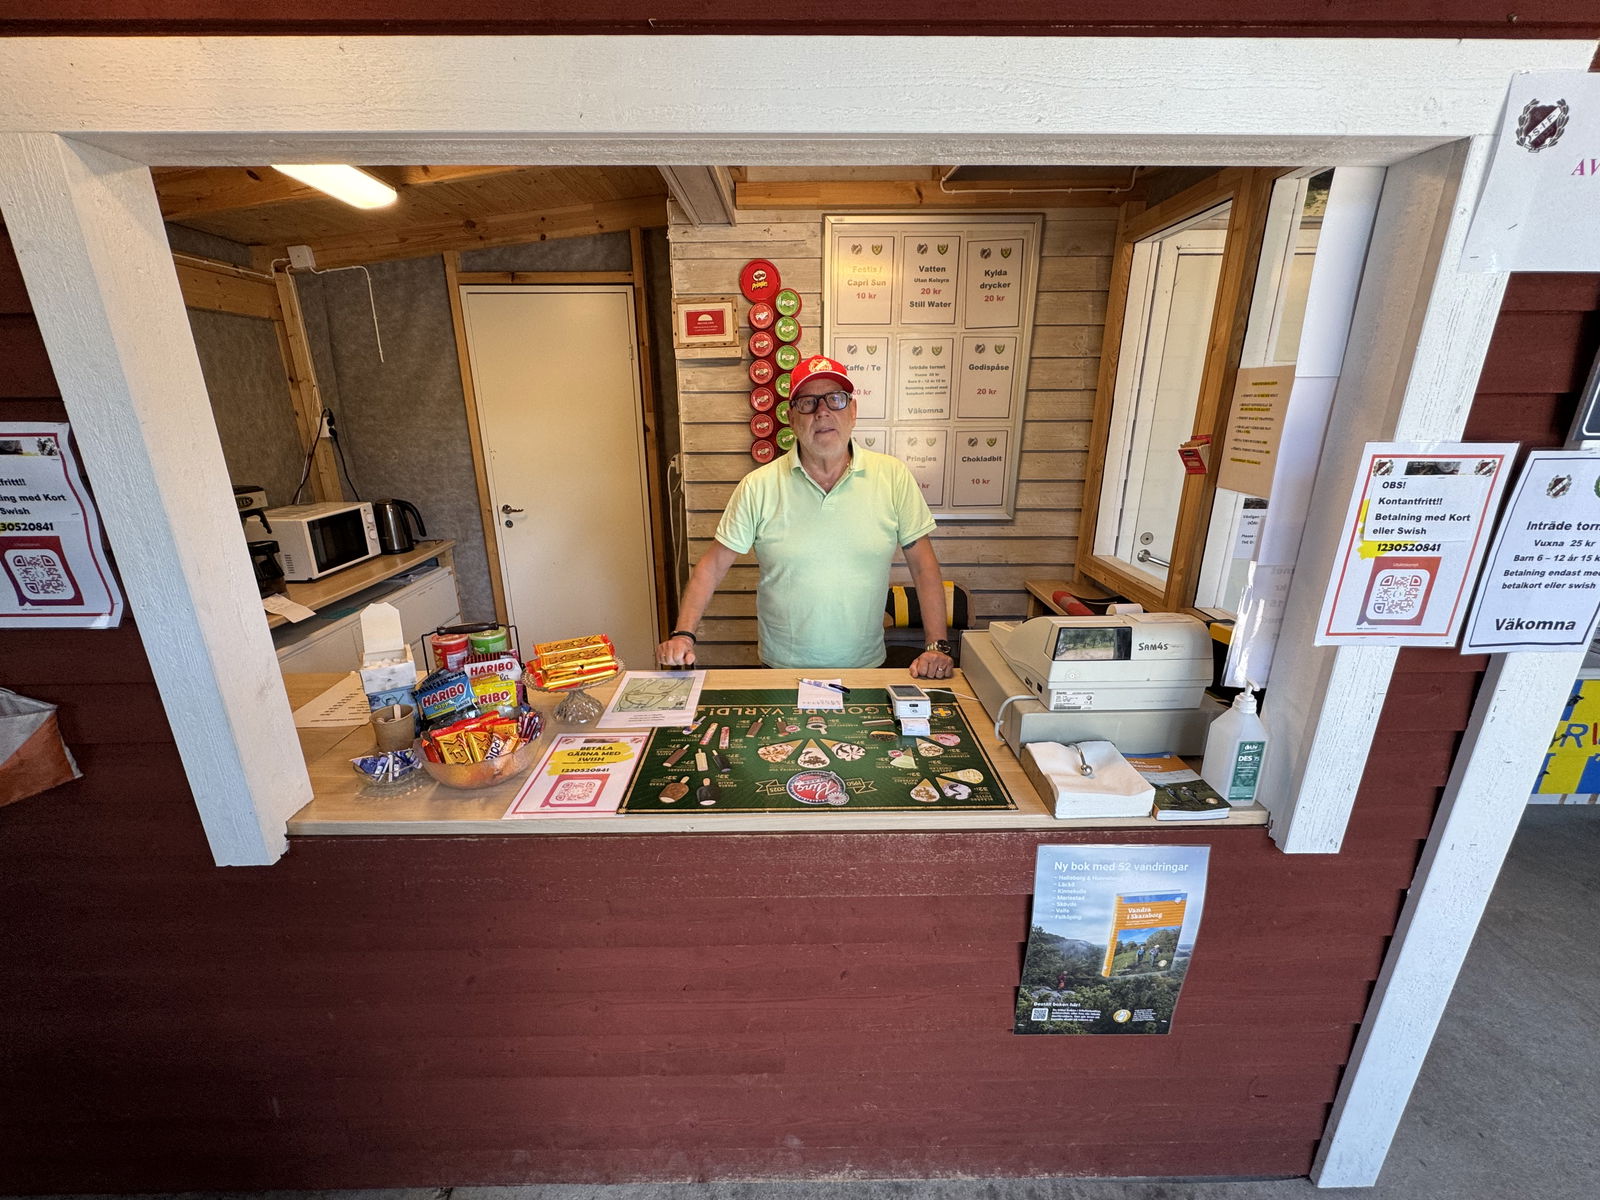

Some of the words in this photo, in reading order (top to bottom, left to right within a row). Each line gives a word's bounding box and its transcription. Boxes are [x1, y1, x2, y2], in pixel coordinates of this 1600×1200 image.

[919, 265, 946, 273] Vatten
[984, 269, 1008, 278] Kylda
[847, 279, 869, 287] Capri
[979, 282, 1011, 291] drycker
[932, 287, 942, 295] kr
[968, 364, 1010, 372] Godispåse
[1381, 481, 1406, 490] OBS!
[1378, 497, 1443, 506] Kontantfritt!!
[0, 507, 31, 515] Swish
[1375, 513, 1422, 523] Betalning
[1424, 513, 1446, 522] med
[1449, 513, 1471, 522] Kort
[0, 522, 54, 531] 30520841
[1526, 520, 1573, 531] Inträde
[1372, 527, 1395, 535] eller
[1397, 527, 1427, 535] Swish
[1376, 543, 1442, 552] 1230520841
[1533, 539, 1565, 547] Vuxna
[1569, 539, 1583, 547] 25
[1584, 539, 1597, 547] kr
[1513, 554, 1535, 562] Barn
[1537, 554, 1543, 562] 6
[1554, 554, 1566, 562] 12
[1567, 553, 1579, 562] år
[1580, 554, 1593, 562] 15
[1503, 569, 1546, 578] Betalning
[1548, 569, 1582, 577] endast
[1495, 617, 1577, 631] Väkomna
[470, 661, 514, 677] HARIBO
[422, 683, 466, 708] HARIBO
[709, 707, 784, 718] VÄRLD!
[1054, 862, 1069, 872] Ny
[1071, 861, 1090, 871] bok
[1092, 862, 1116, 871] med
[1118, 863, 1131, 871] 52
[1134, 862, 1189, 873] vandringar
[1130, 912, 1163, 920] Skaraborg
